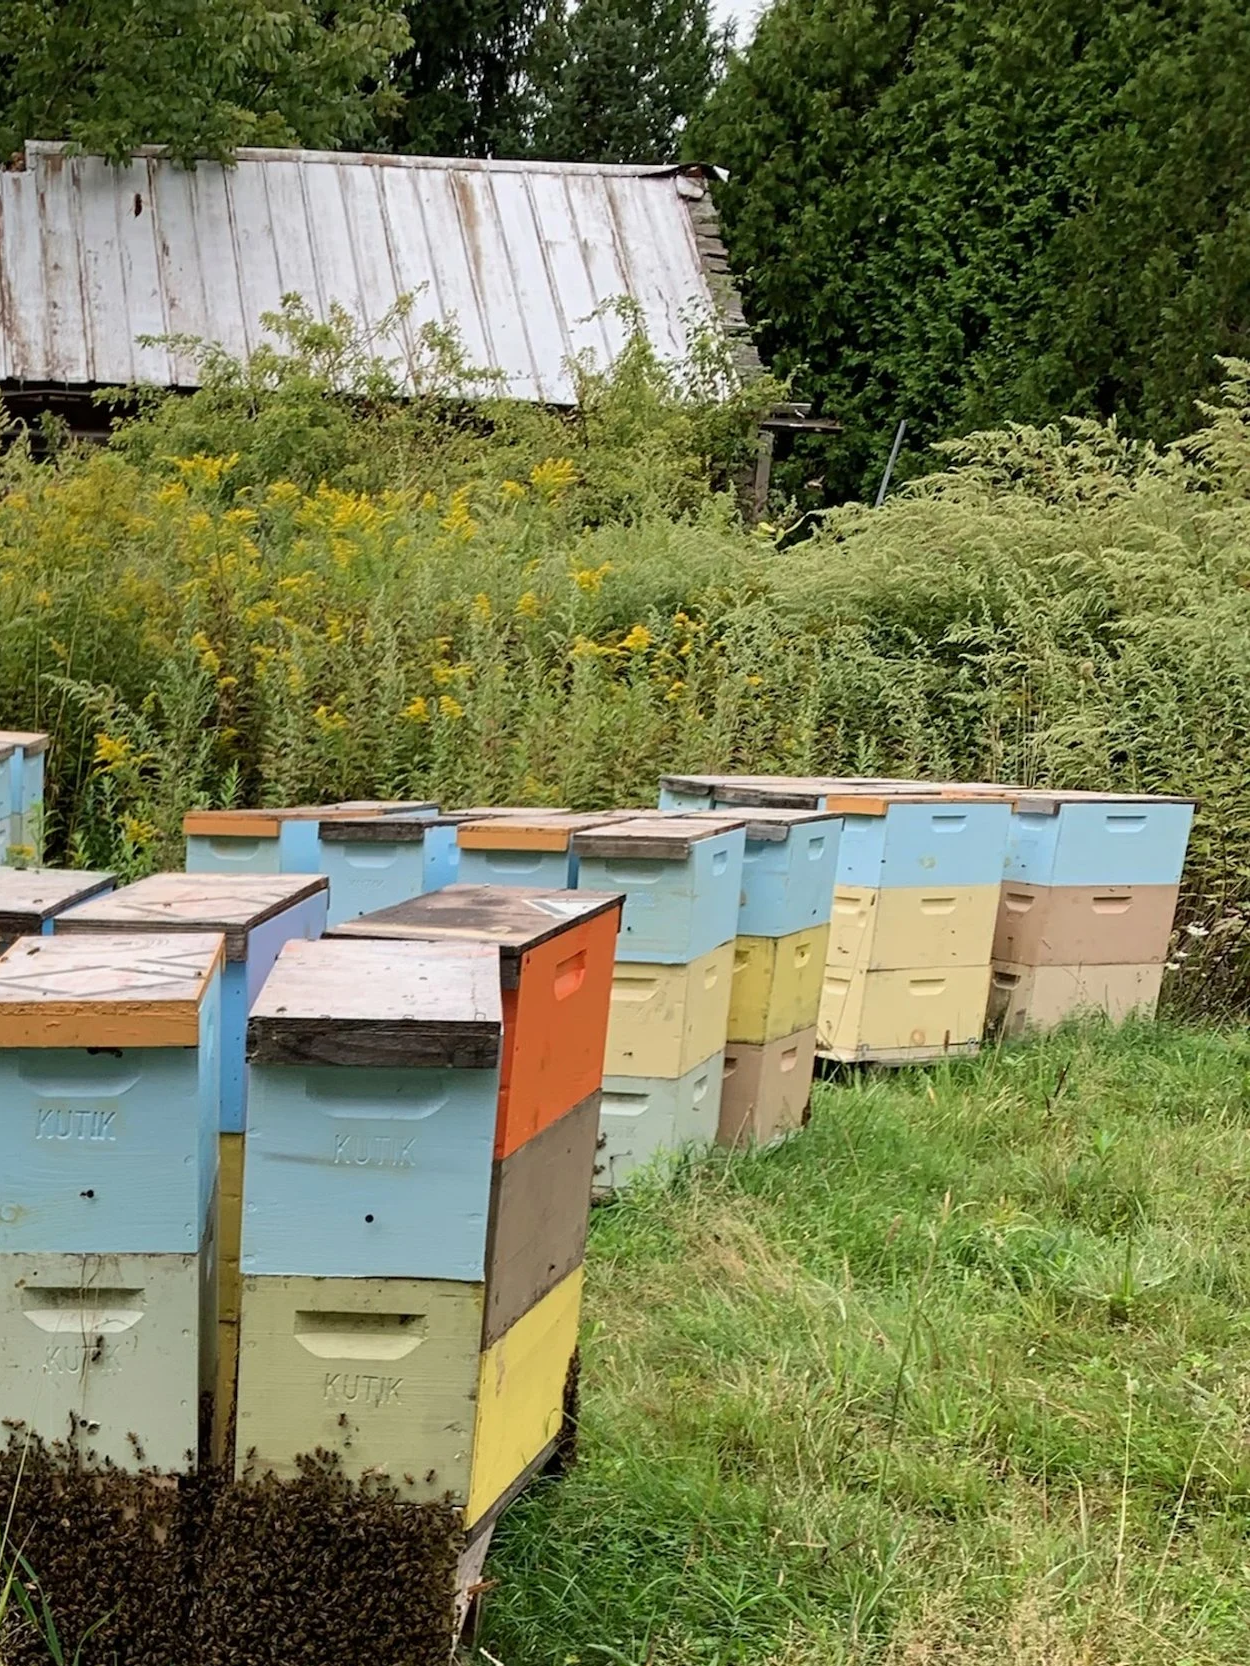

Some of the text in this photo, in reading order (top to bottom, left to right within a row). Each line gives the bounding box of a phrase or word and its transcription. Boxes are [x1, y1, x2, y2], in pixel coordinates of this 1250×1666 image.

[35, 1108, 117, 1141] KUTIK
[333, 1133, 417, 1167] KUTIK
[323, 1372, 403, 1406] KUTIK
